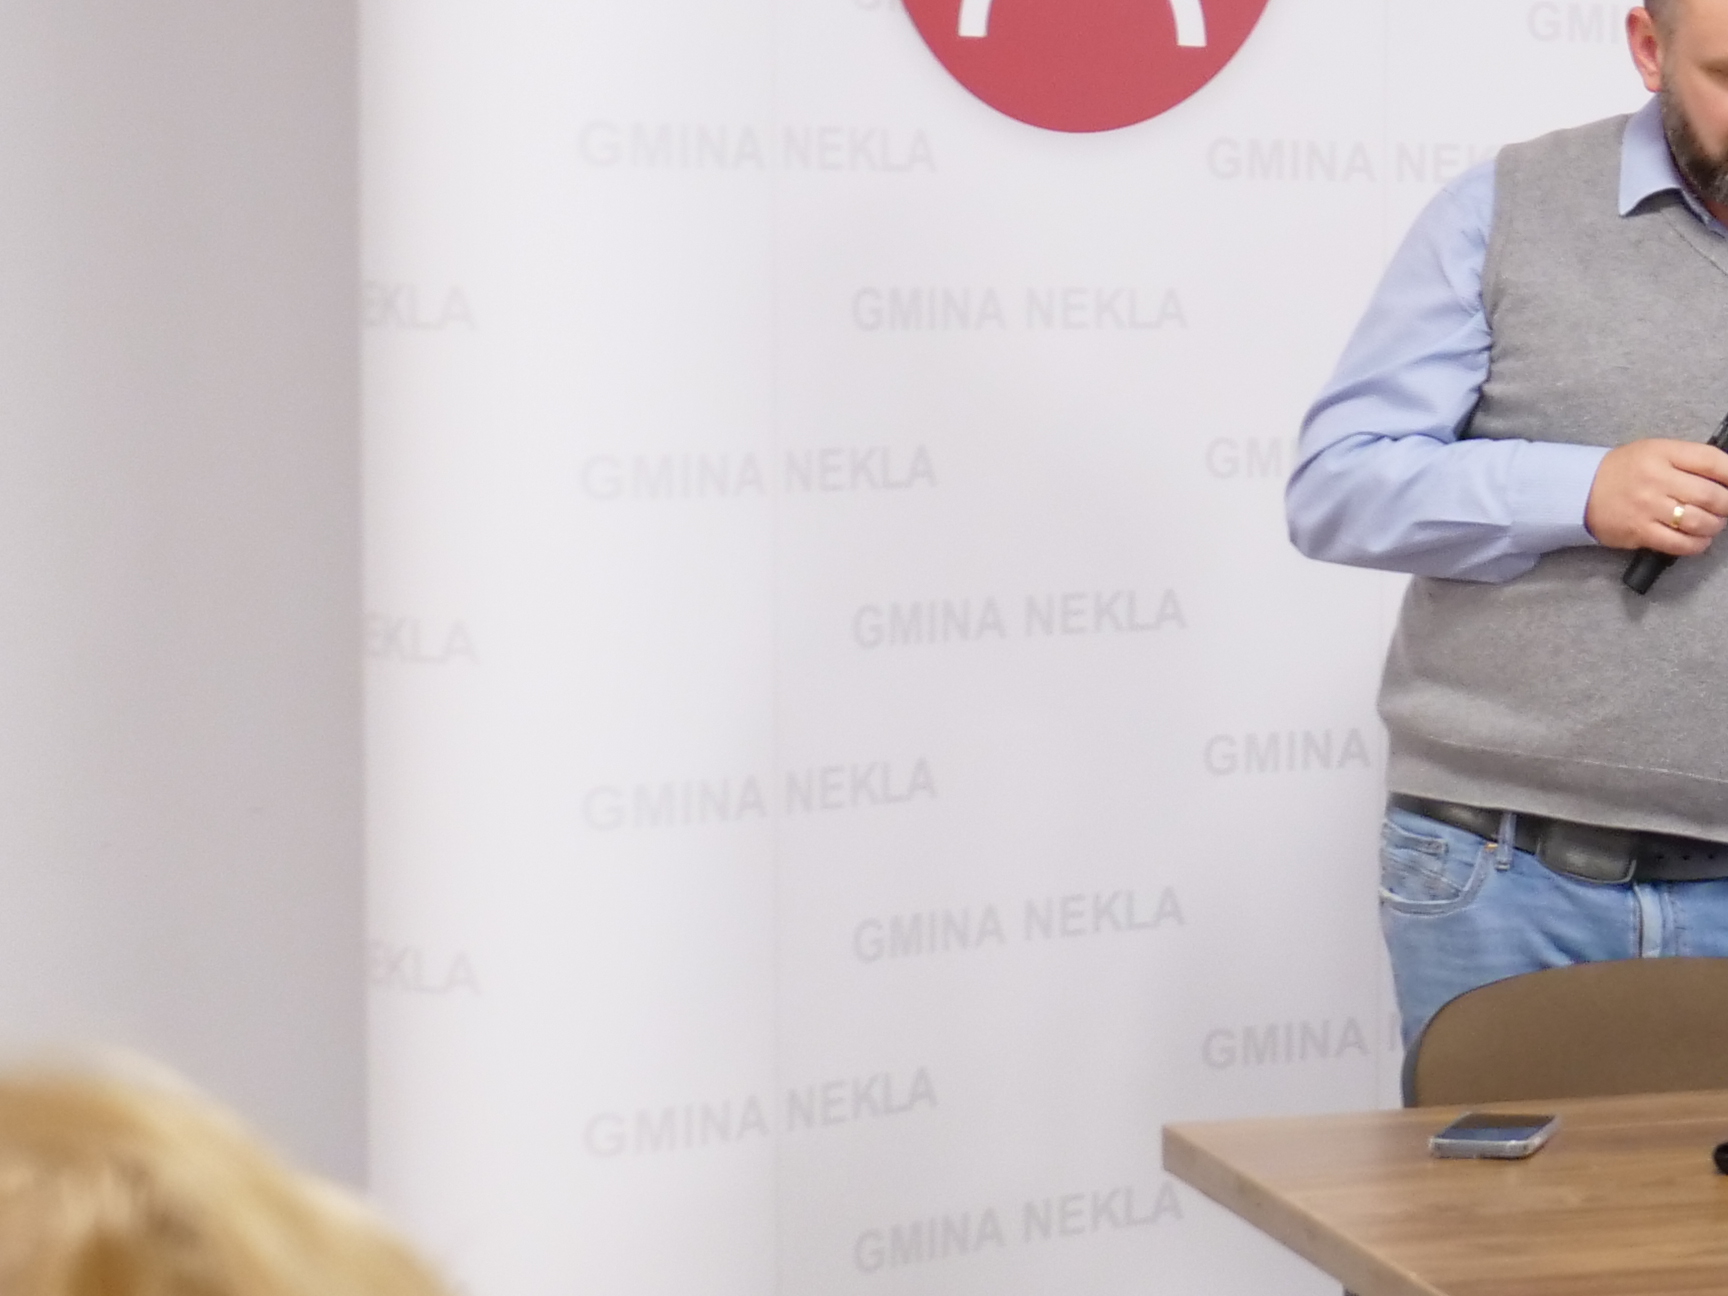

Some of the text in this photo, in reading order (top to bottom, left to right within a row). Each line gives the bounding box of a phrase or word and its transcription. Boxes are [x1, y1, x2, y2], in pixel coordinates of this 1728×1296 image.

[578, 120, 936, 173] GMINA NEKLA
[1206, 137, 1376, 182] GMINA
[851, 286, 1188, 333] GMINA NEKLA
[581, 444, 939, 501] GMINA NEKLA
[852, 588, 1187, 650] GMINA NEKLA
[1203, 728, 1371, 777] GMINA
[582, 756, 939, 831] GMINA NEKLA
[852, 886, 1186, 965] GMINA NEKLA
[1201, 1017, 1370, 1071] GMINA
[583, 1066, 938, 1158] GMINA NEKLA
[853, 1180, 1184, 1276] GMINA NEKLA
